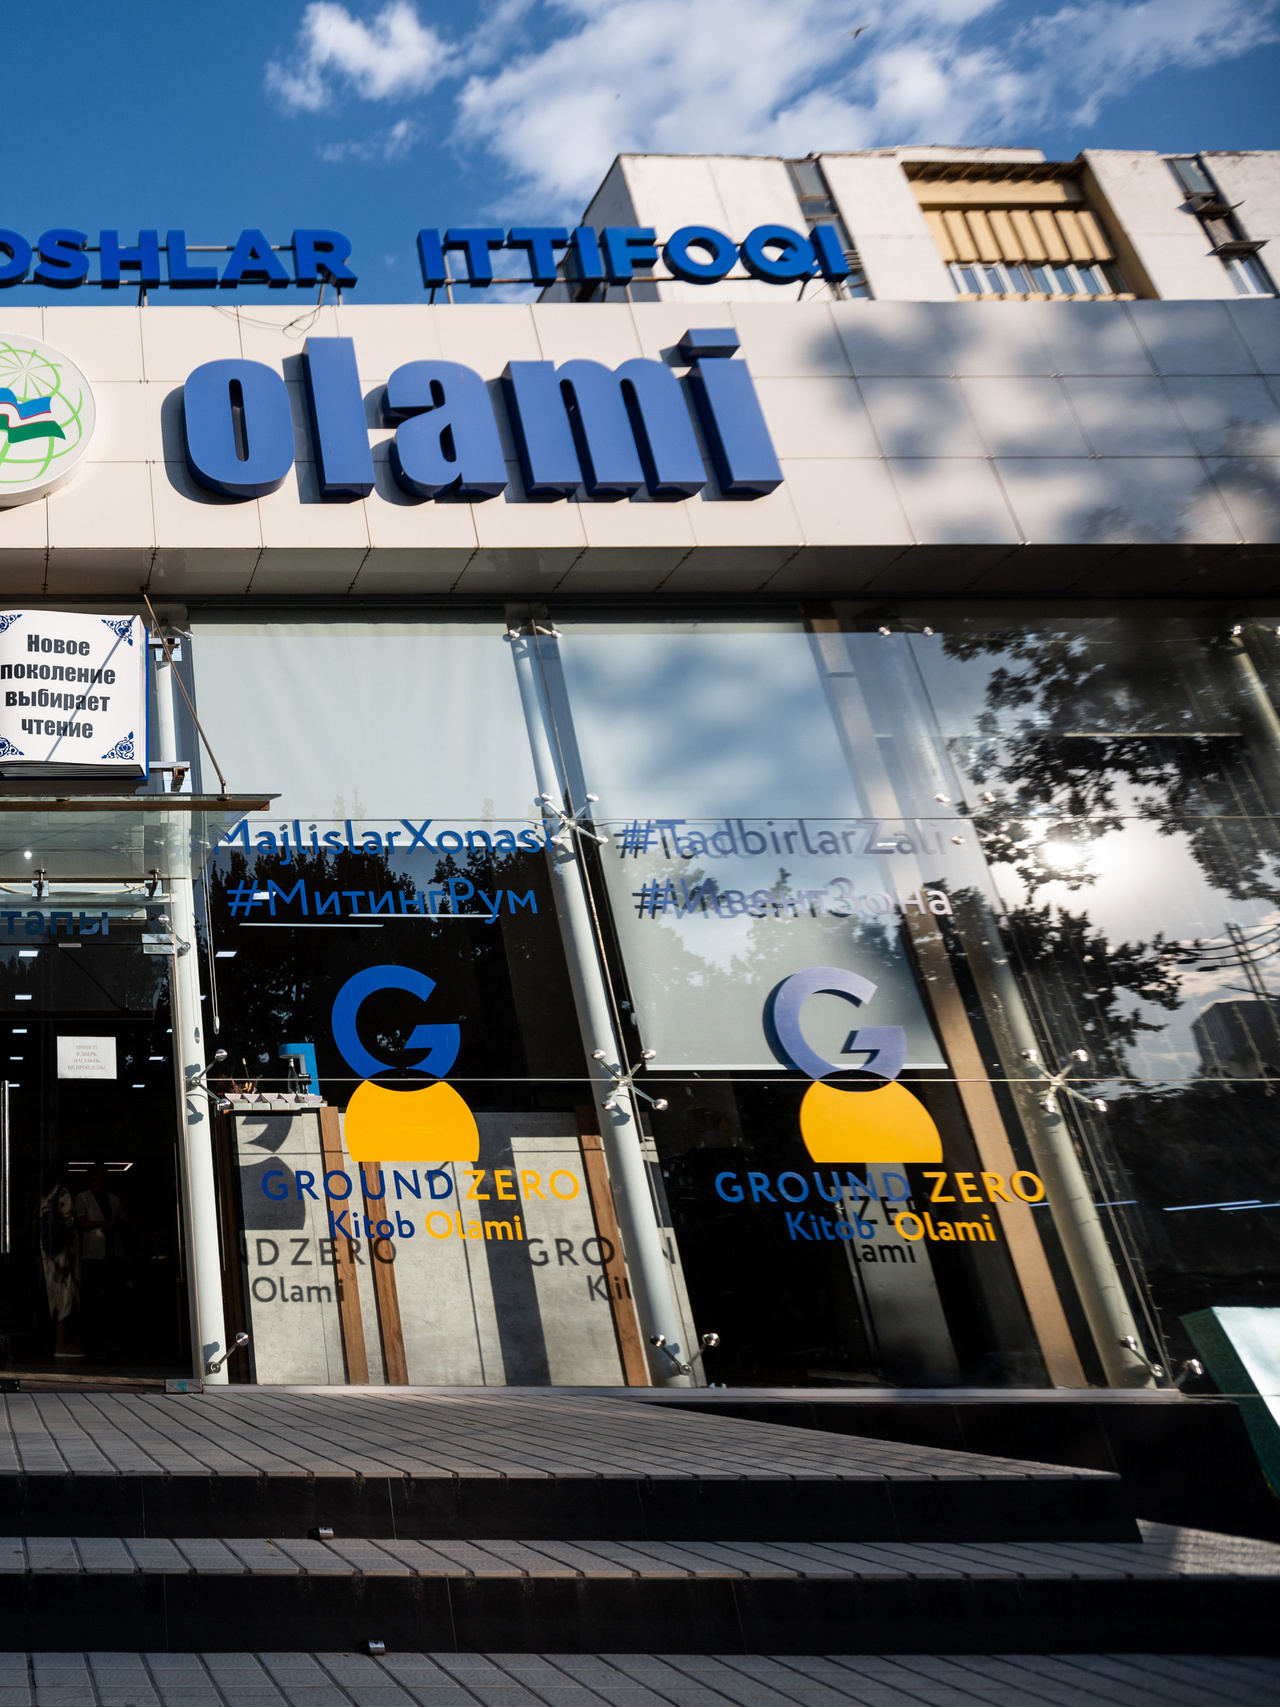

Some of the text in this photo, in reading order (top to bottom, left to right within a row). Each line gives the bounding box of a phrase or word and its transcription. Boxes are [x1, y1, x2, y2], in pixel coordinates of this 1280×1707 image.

[417, 225, 851, 287] ITTIFOQI
[183, 328, 784, 500] olami
[27, 634, 91, 657] Новое
[0, 663, 116, 685] поколение
[5, 689, 110, 712] выбирает
[21, 717, 94, 739] чтение
[200, 820, 554, 866] MajlislarXonasi
[227, 877, 538, 924] #МитингРум
[261, 1169, 580, 1200] GROUND ZERO
[715, 1171, 1045, 1203] GROUND ZERO
[329, 1210, 523, 1240] Kitob Olami
[784, 1211, 875, 1240] Kitob
[894, 1212, 997, 1241] Olami
